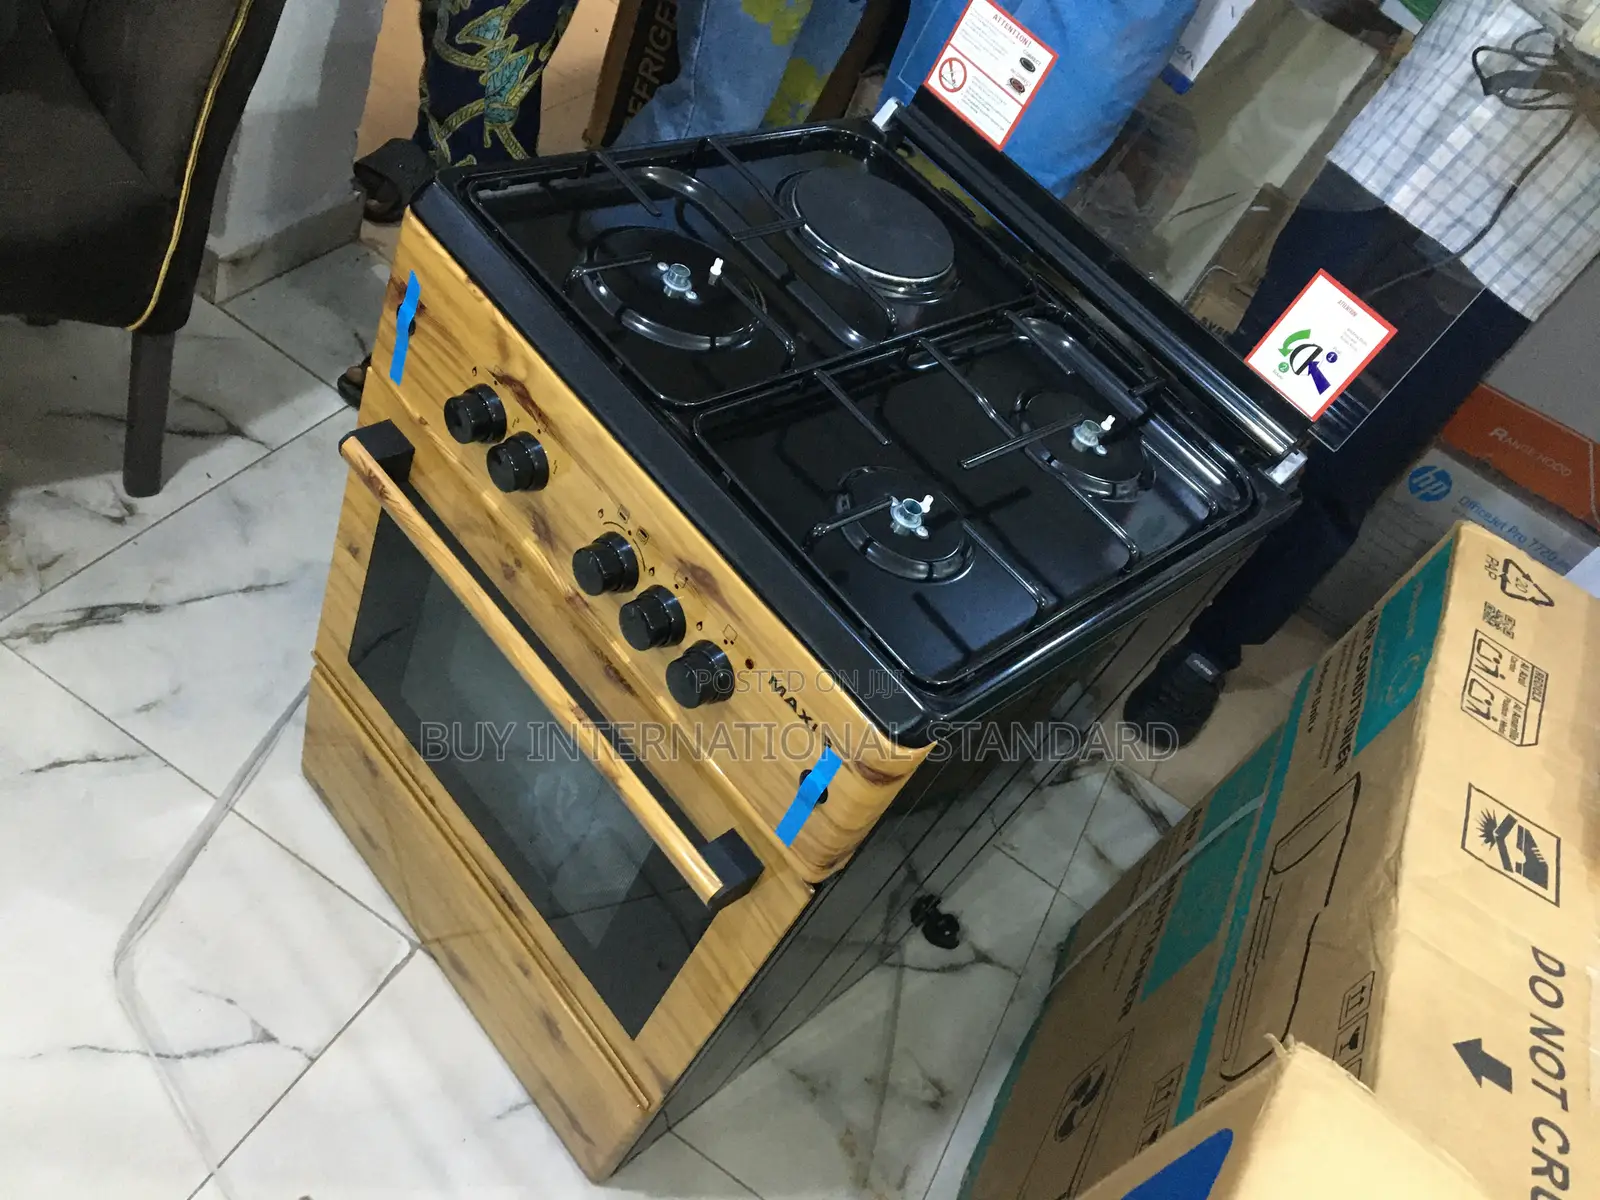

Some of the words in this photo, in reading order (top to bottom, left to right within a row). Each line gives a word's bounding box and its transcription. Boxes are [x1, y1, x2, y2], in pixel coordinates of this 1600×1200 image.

[992, 13, 1032, 48] ATTENTION!
[624, 0, 677, 125] EFRIGE
[1484, 554, 1500, 581] PAP
[1508, 524, 1528, 546] Pro
[1528, 538, 1556, 562] 7720
[1334, 644, 1372, 775] CONDITIONER
[1531, 670, 1545, 703] RECICLA
[1528, 946, 1566, 1009] DO
[1528, 1013, 1570, 1112] NOT
